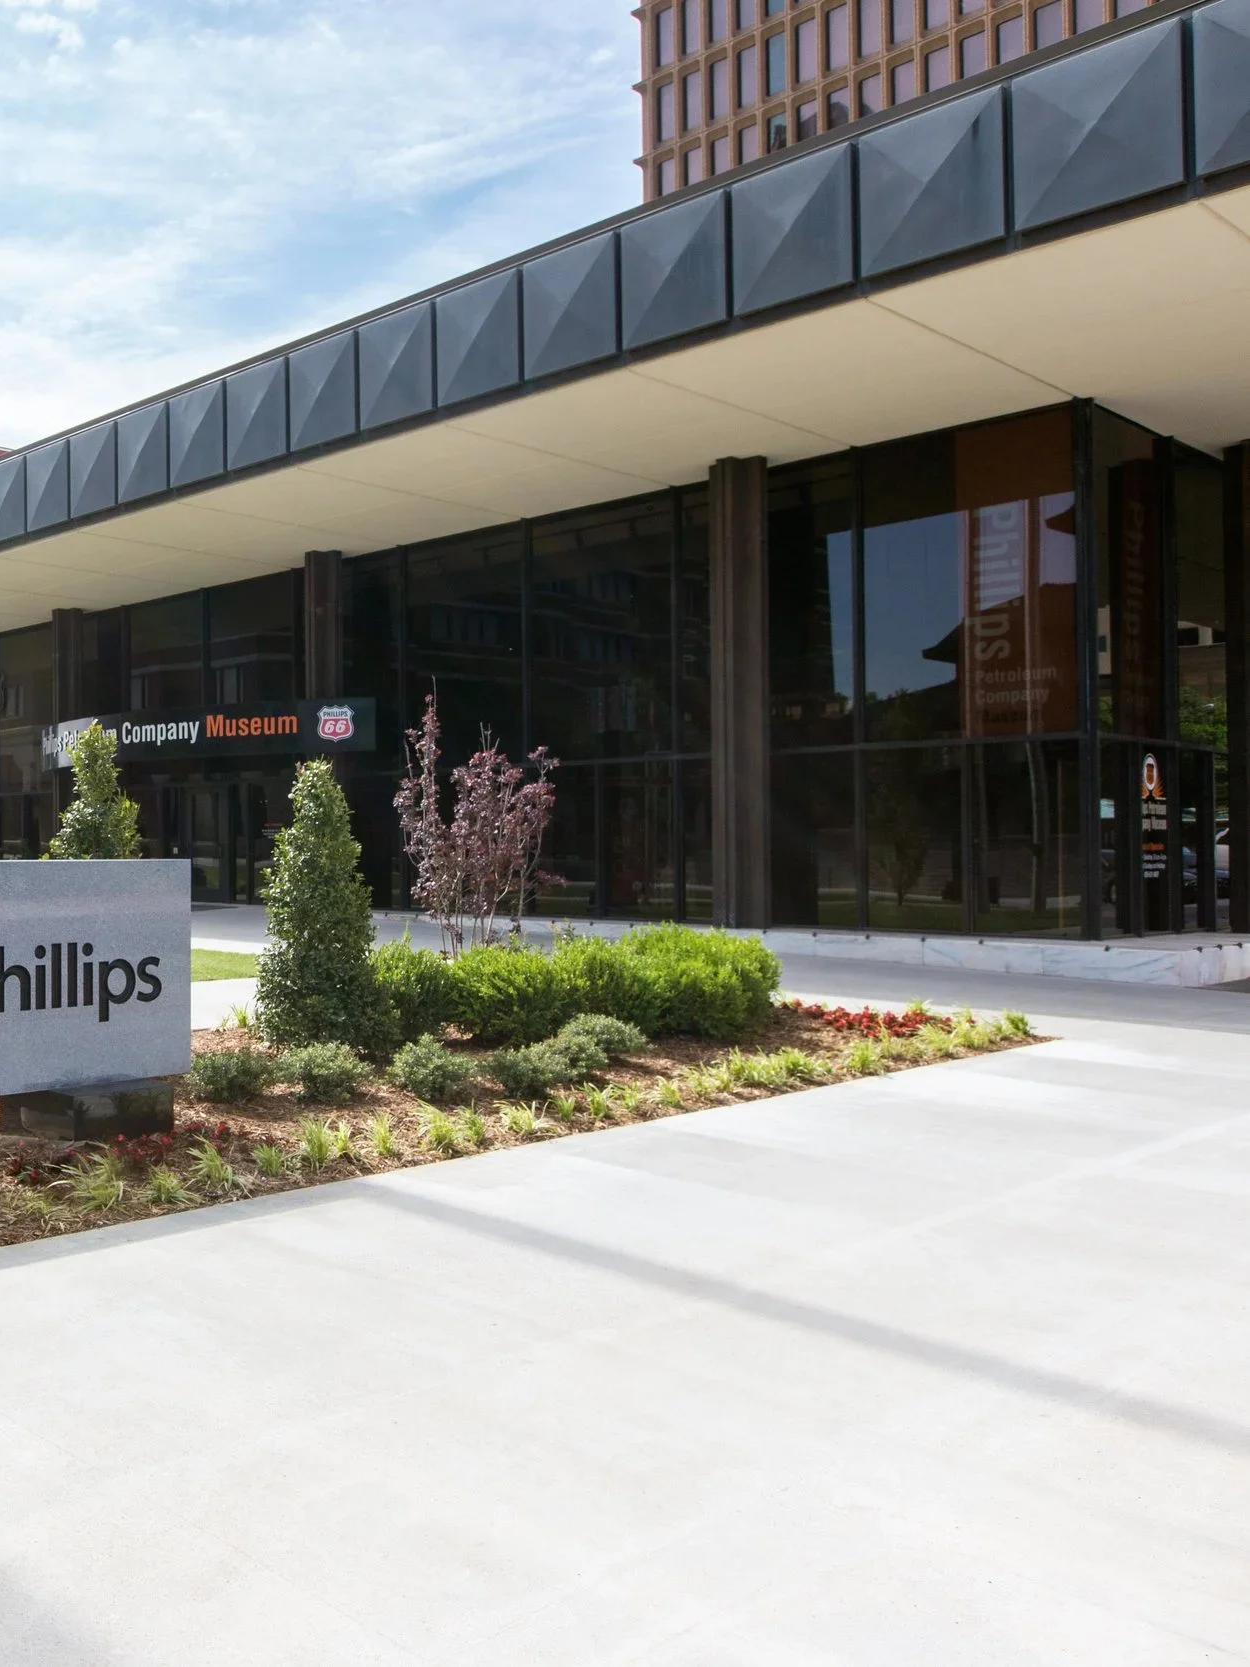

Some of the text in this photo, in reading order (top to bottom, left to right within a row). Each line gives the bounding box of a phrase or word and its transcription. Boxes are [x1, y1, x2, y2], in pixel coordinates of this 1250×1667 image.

[975, 666, 1057, 684] Petroleum
[975, 687, 1050, 705] Company
[122, 721, 200, 746] Company
[206, 714, 298, 738] Museum
[324, 720, 347, 734] 66
